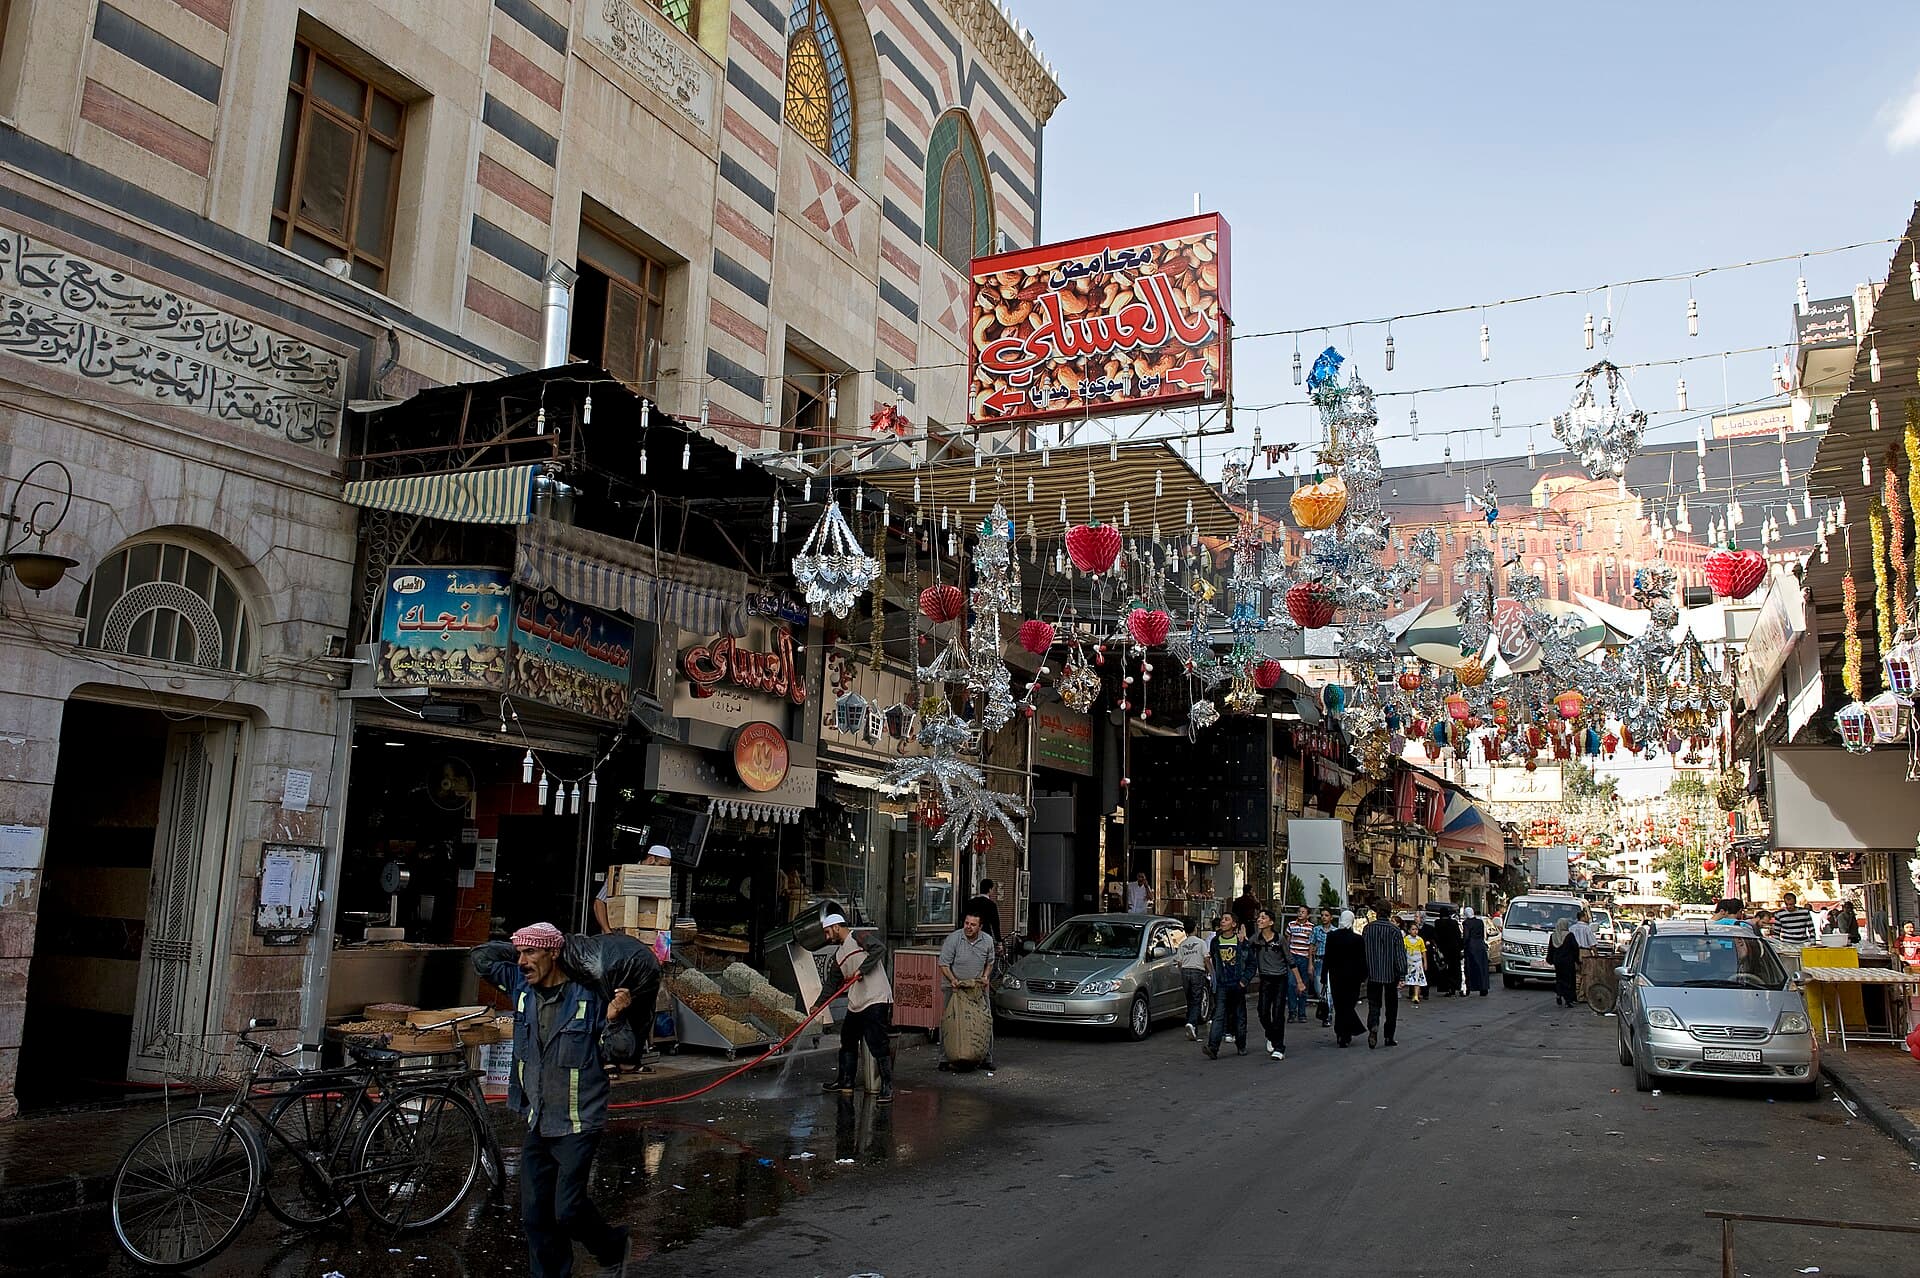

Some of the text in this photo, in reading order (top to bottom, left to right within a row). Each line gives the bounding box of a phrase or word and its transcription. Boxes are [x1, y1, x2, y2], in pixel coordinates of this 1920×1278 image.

[1049, 246, 1153, 289] محامص
[979, 274, 1212, 388] العسلي
[1031, 373, 1161, 405] بن وكولا هديا
[446, 573, 511, 596] محمصة
[397, 600, 500, 642] منجك
